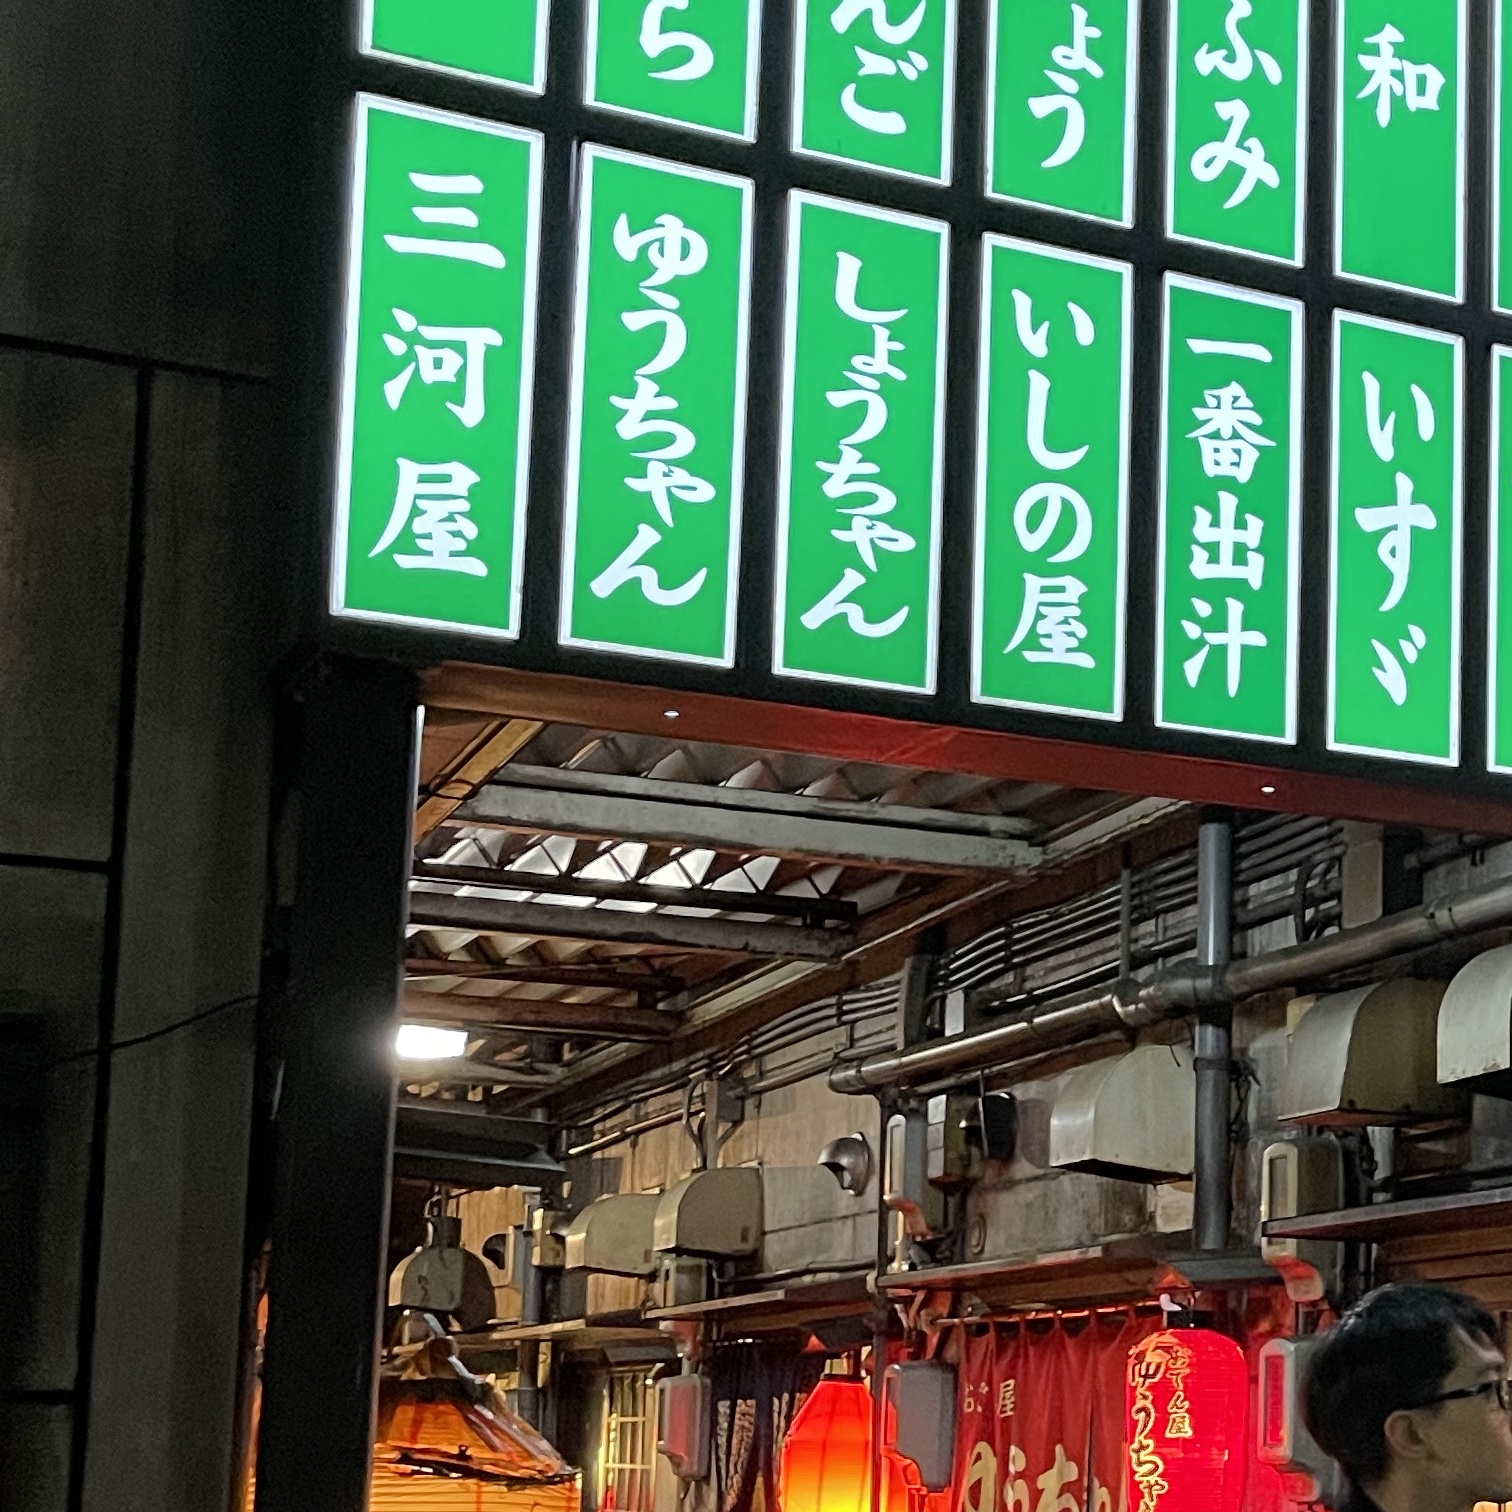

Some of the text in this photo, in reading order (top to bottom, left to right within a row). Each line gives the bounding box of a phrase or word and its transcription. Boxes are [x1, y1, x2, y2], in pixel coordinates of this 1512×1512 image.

[1028, 4, 1103, 167] ょう
[1191, 0, 1282, 208] ふみ
[1357, 24, 1445, 127] 和
[370, 173, 505, 576] 三河屋
[590, 214, 715, 605] ゆうちゃん
[800, 252, 916, 637] しょうちゃん
[1004, 289, 1095, 668] いしの屋
[1182, 339, 1276, 697] 一番出汁
